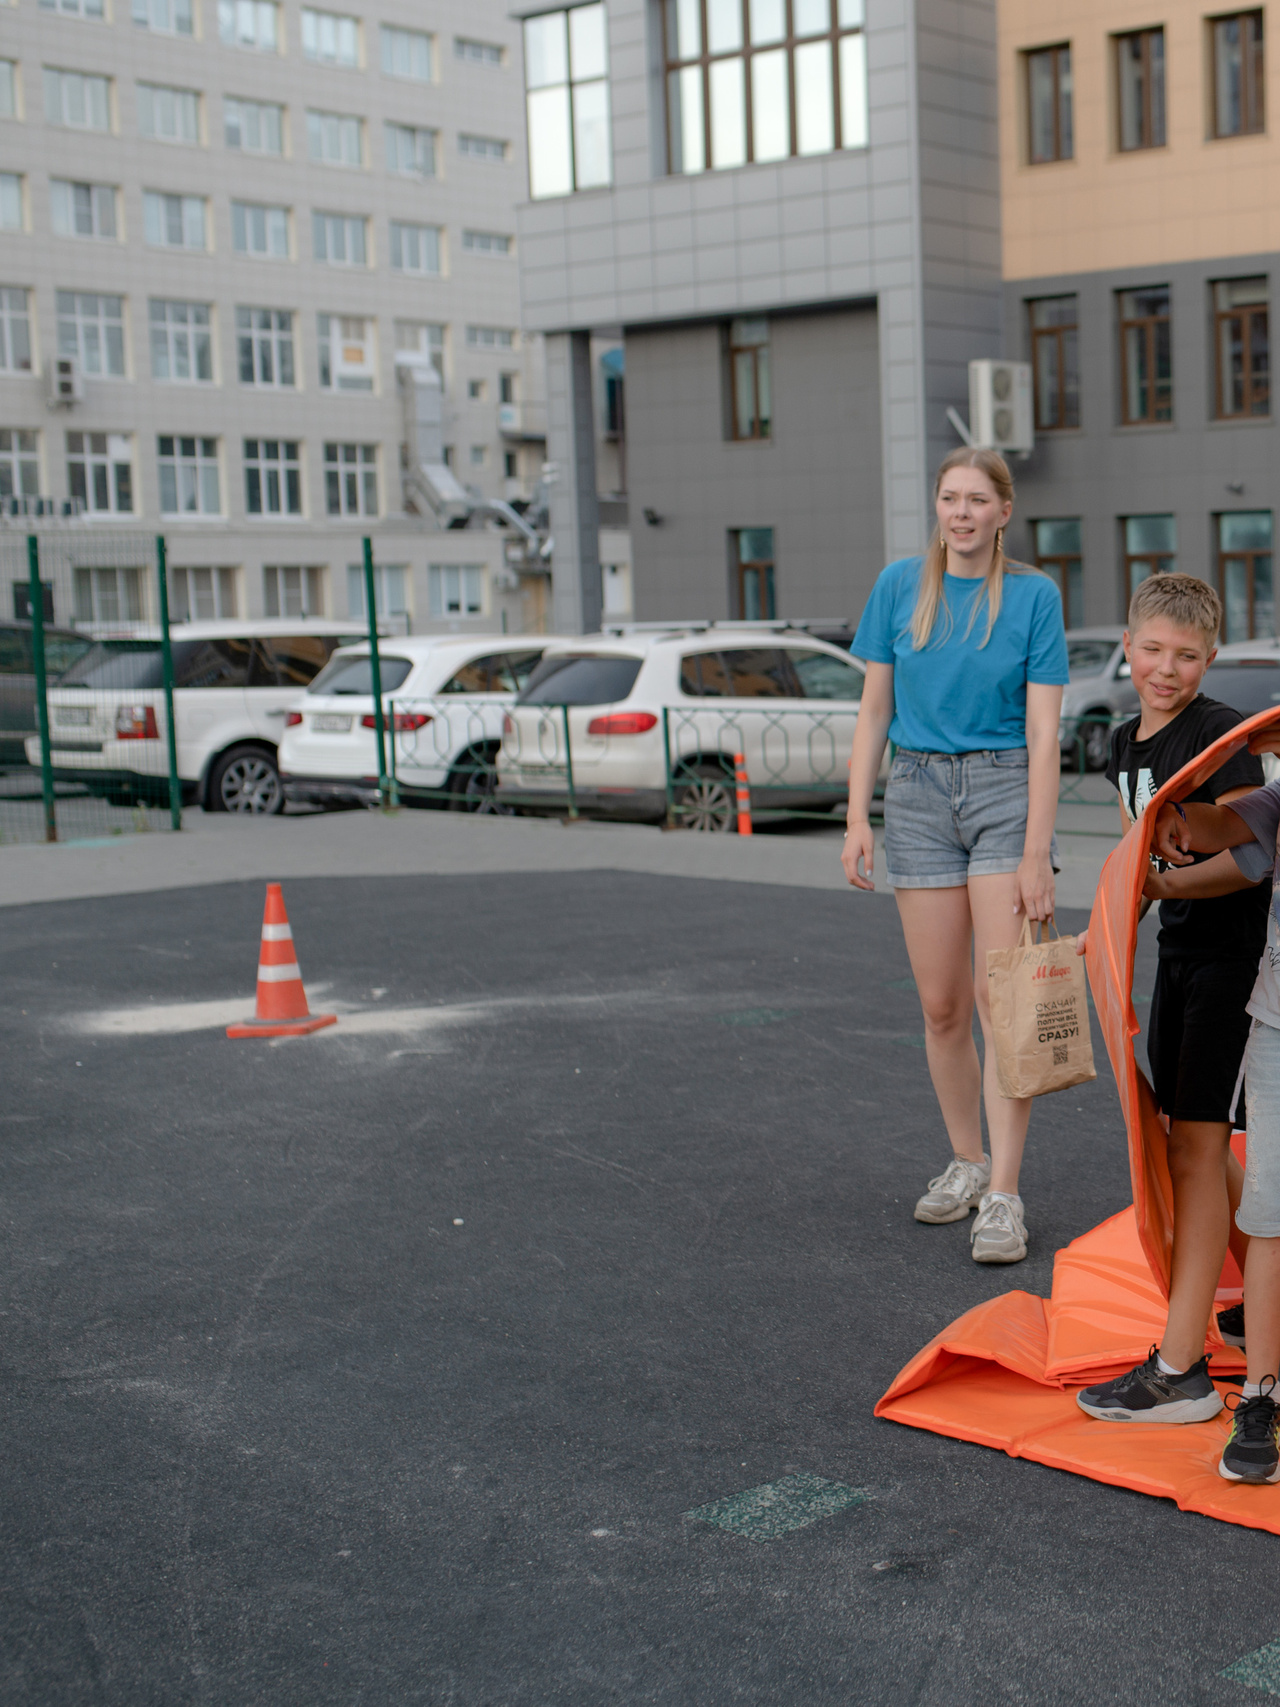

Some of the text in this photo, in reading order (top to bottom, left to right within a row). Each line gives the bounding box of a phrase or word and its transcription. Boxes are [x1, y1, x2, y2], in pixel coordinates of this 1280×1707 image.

[1035, 995, 1076, 1012] СКАЧАЙ
[1037, 1013, 1078, 1026] ПОЛУЧИ ВСЕ
[1038, 1026, 1079, 1043] СРАЗУ!
